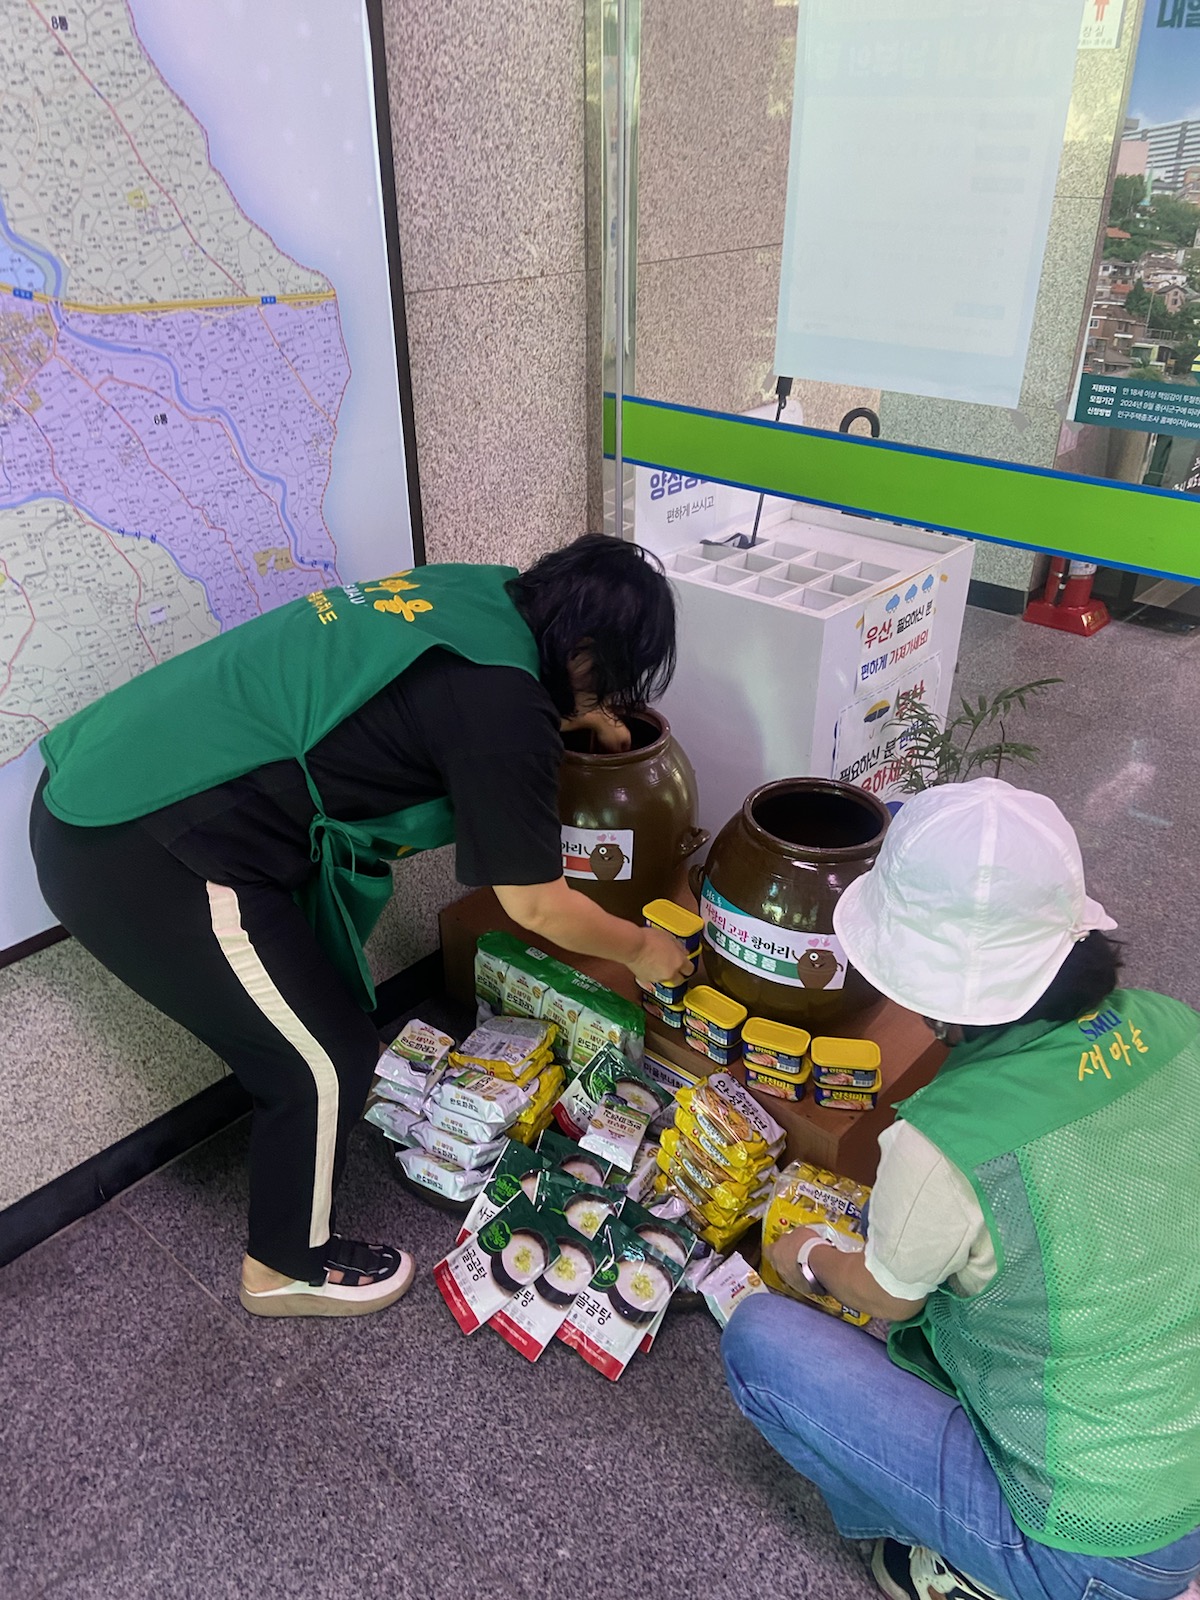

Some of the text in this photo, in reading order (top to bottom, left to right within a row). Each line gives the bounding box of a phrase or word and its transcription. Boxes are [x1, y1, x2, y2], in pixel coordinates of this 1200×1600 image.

[1089, 395, 1114, 405] 모집기간
[1120, 400, 1142, 409] 2024년
[1091, 384, 1117, 394] 지원자격
[1130, 389, 1143, 397] 18세
[1144, 390, 1157, 399] 이상
[1087, 407, 1111, 417] 신청방법
[667, 496, 714, 523] 편하게 쓰시고
[864, 600, 934, 649] 우산, 필요하신 분
[861, 654, 888, 681] 편하게
[883, 738, 897, 760] 분
[705, 903, 790, 959] 사랑의 고팡 항아리
[715, 931, 777, 972] 생활용품
[757, 1074, 796, 1092] 런천미트
[714, 1080, 768, 1131] 안성탕면
[814, 1189, 846, 1211] 안성탕면
[576, 1291, 612, 1326] 골곰탕
